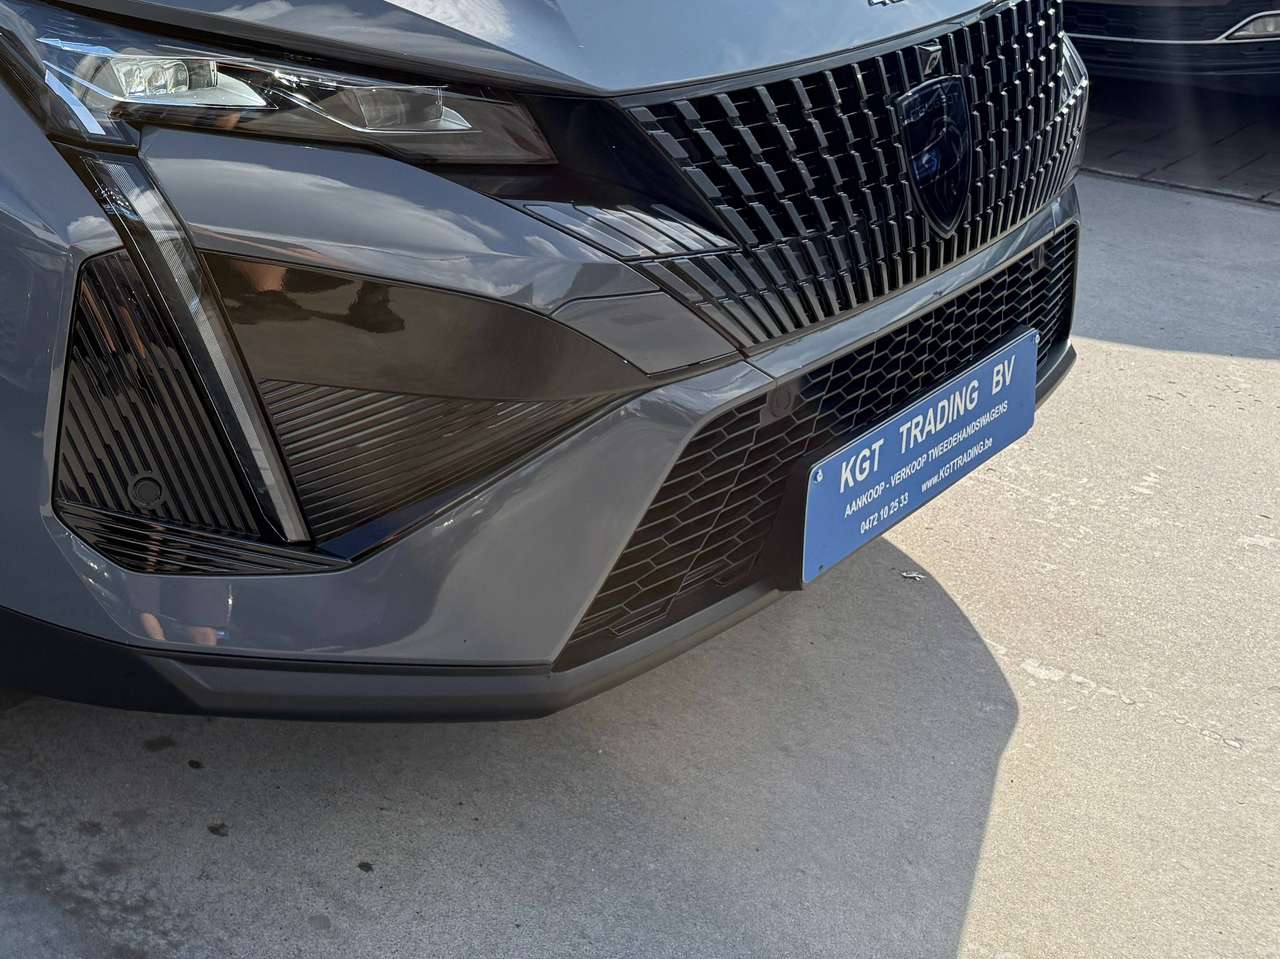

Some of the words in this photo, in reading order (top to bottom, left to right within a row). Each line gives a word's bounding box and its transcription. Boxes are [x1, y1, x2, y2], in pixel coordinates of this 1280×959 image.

[839, 438, 885, 494] KGT
[899, 379, 979, 455] TRADING
[991, 355, 1016, 395] BV
[844, 482, 885, 518] AANKOOP
[890, 454, 927, 488] VERKOOP
[927, 401, 1008, 462] TWEEDEHANDSWAGENS
[921, 437, 993, 493] www.KGTTRADING.be
[860, 513, 878, 535] 0472
[879, 506, 889, 522] 10
[889, 499, 899, 516] 25
[900, 492, 909, 508] 33
